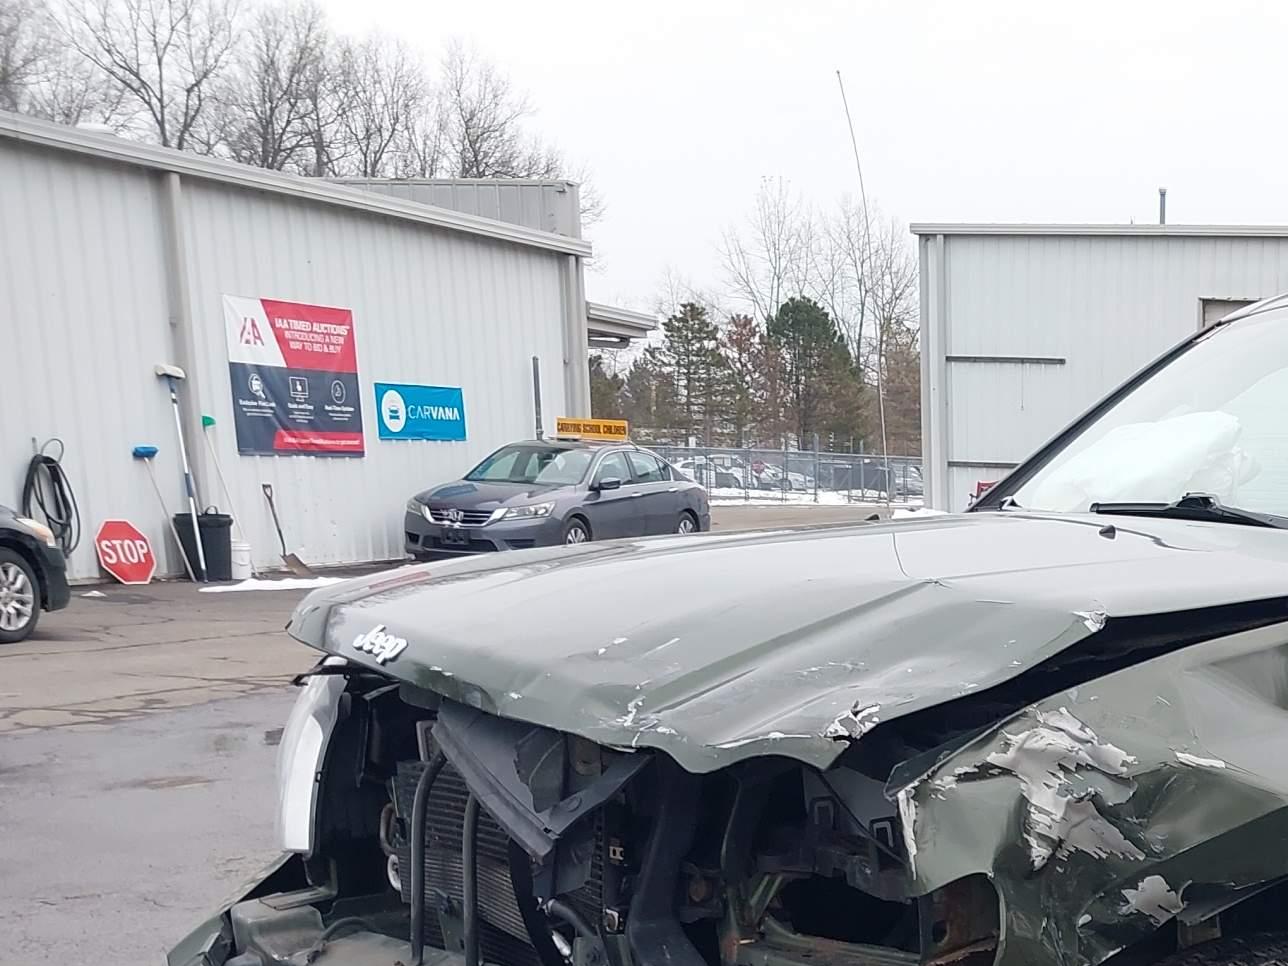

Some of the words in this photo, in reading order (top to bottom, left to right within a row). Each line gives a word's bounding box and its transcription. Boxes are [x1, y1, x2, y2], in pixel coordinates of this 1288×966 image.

[304, 342, 312, 351] TO
[408, 405, 461, 421] CARVANA
[583, 423, 601, 434] SCHOOL
[100, 540, 148, 564] STOP
